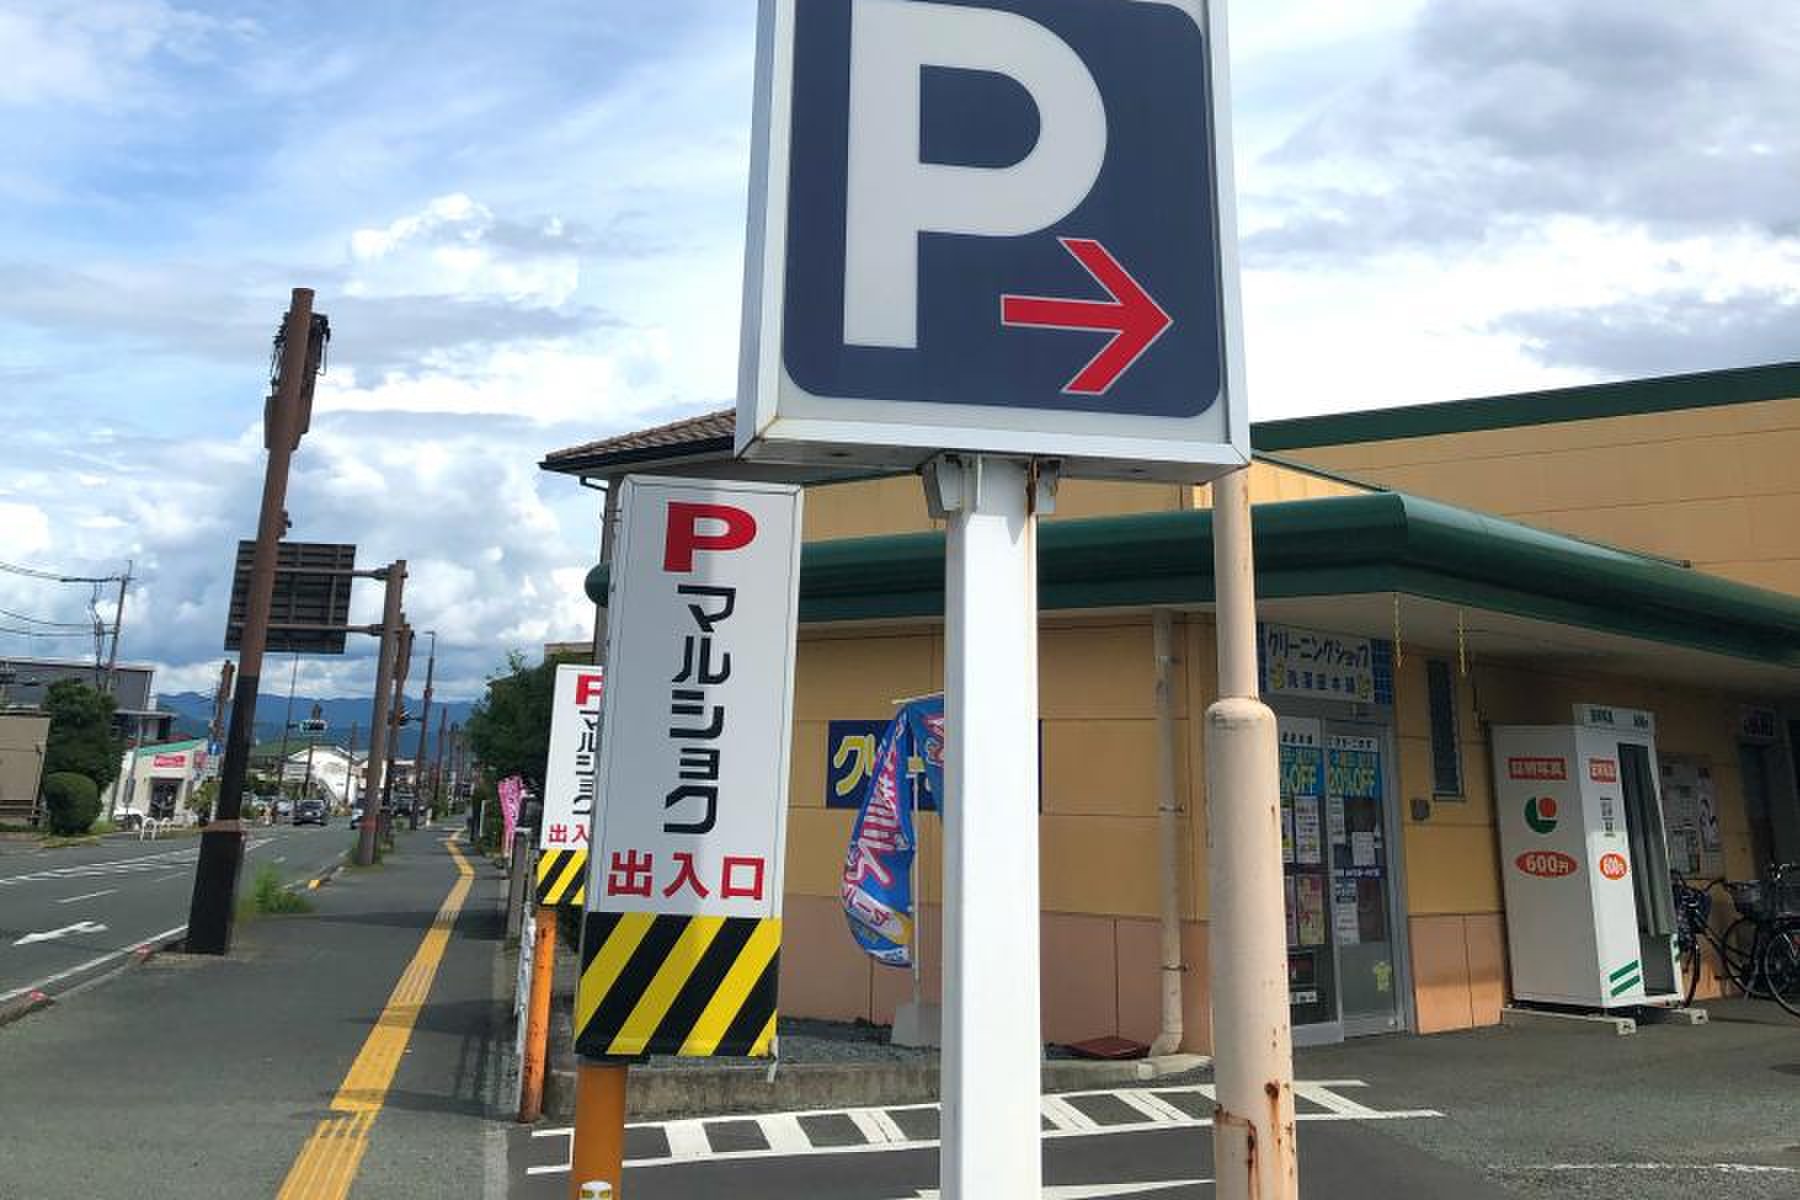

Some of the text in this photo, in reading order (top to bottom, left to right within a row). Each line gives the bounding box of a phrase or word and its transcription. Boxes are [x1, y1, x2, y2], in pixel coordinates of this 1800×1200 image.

[663, 501, 757, 573] P
[663, 584, 736, 834] マルショク
[607, 849, 764, 901] 出入口
